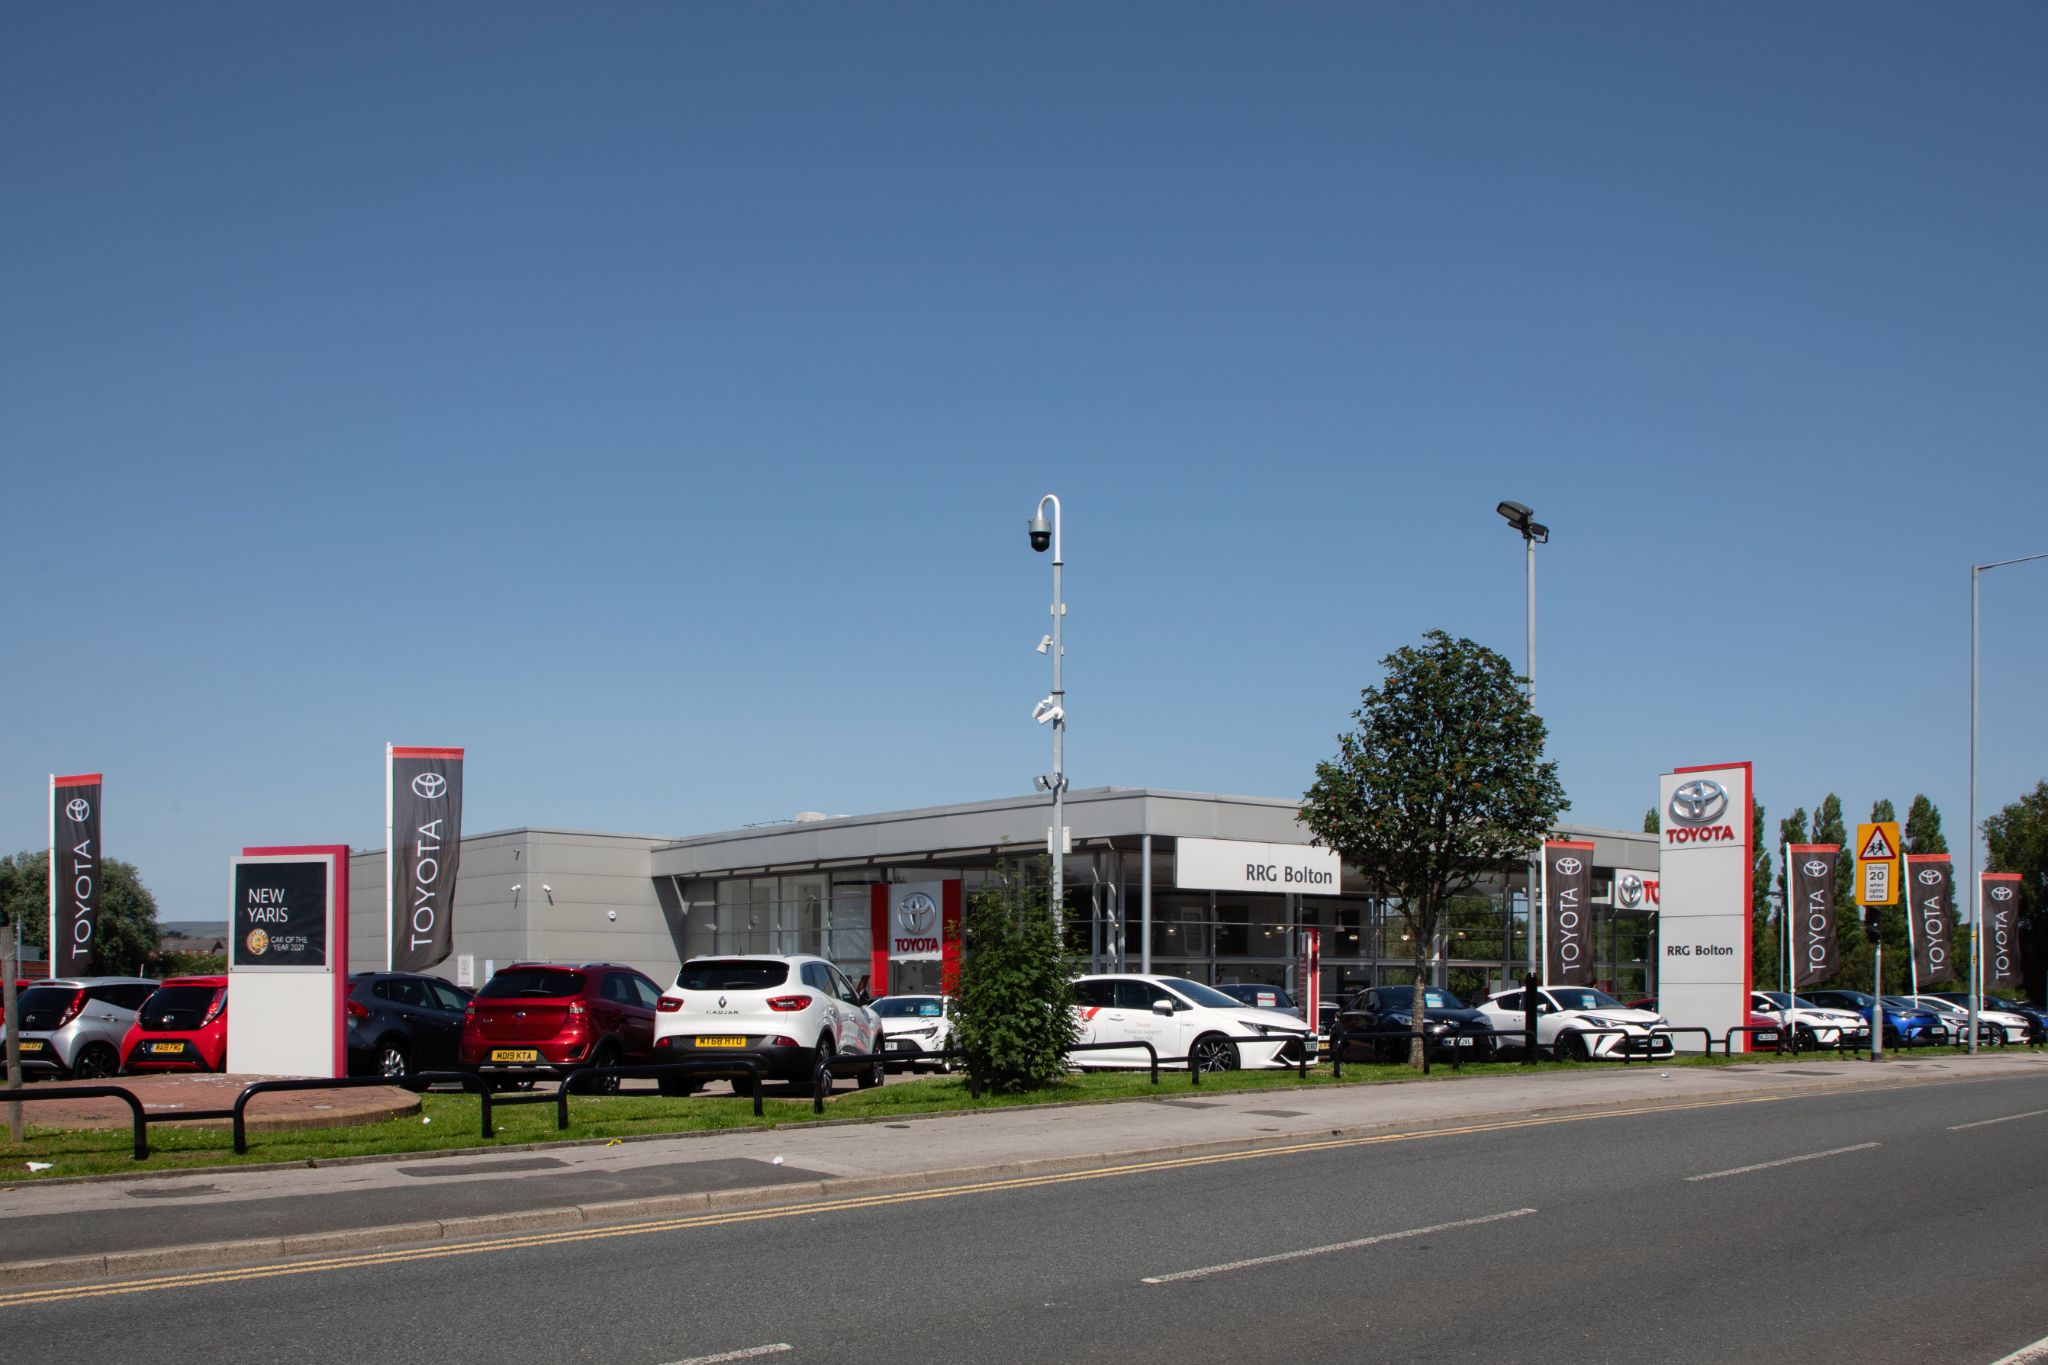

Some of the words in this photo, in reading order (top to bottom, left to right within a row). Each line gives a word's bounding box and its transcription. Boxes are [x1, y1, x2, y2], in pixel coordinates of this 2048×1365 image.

[1666, 825, 1735, 844] TOYOTA
[1246, 863, 1277, 882] RRG
[1284, 866, 1332, 884] Bolton
[1870, 871, 1884, 880] 20
[410, 819, 443, 951] TOYOTA
[72, 839, 92, 960] TOYOTA
[248, 888, 285, 904] NEW
[247, 907, 289, 923] YARIS
[1560, 887, 1580, 974] TOYOTA
[1809, 889, 1826, 973] TOYOTA
[1923, 896, 1945, 974] TOYOTA
[271, 936, 284, 944] CAR
[285, 936, 294, 944] OF
[295, 936, 308, 944] THE
[273, 943, 289, 951] YEAR
[291, 943, 305, 951] 2021
[895, 937, 940, 953] TOYOTA
[1995, 910, 2012, 980] TOYOTA
[1667, 945, 1690, 956] RRG
[1695, 944, 1733, 956] Bolton
[496, 1051, 514, 1060] MD19
[516, 1051, 532, 1060] KTA
